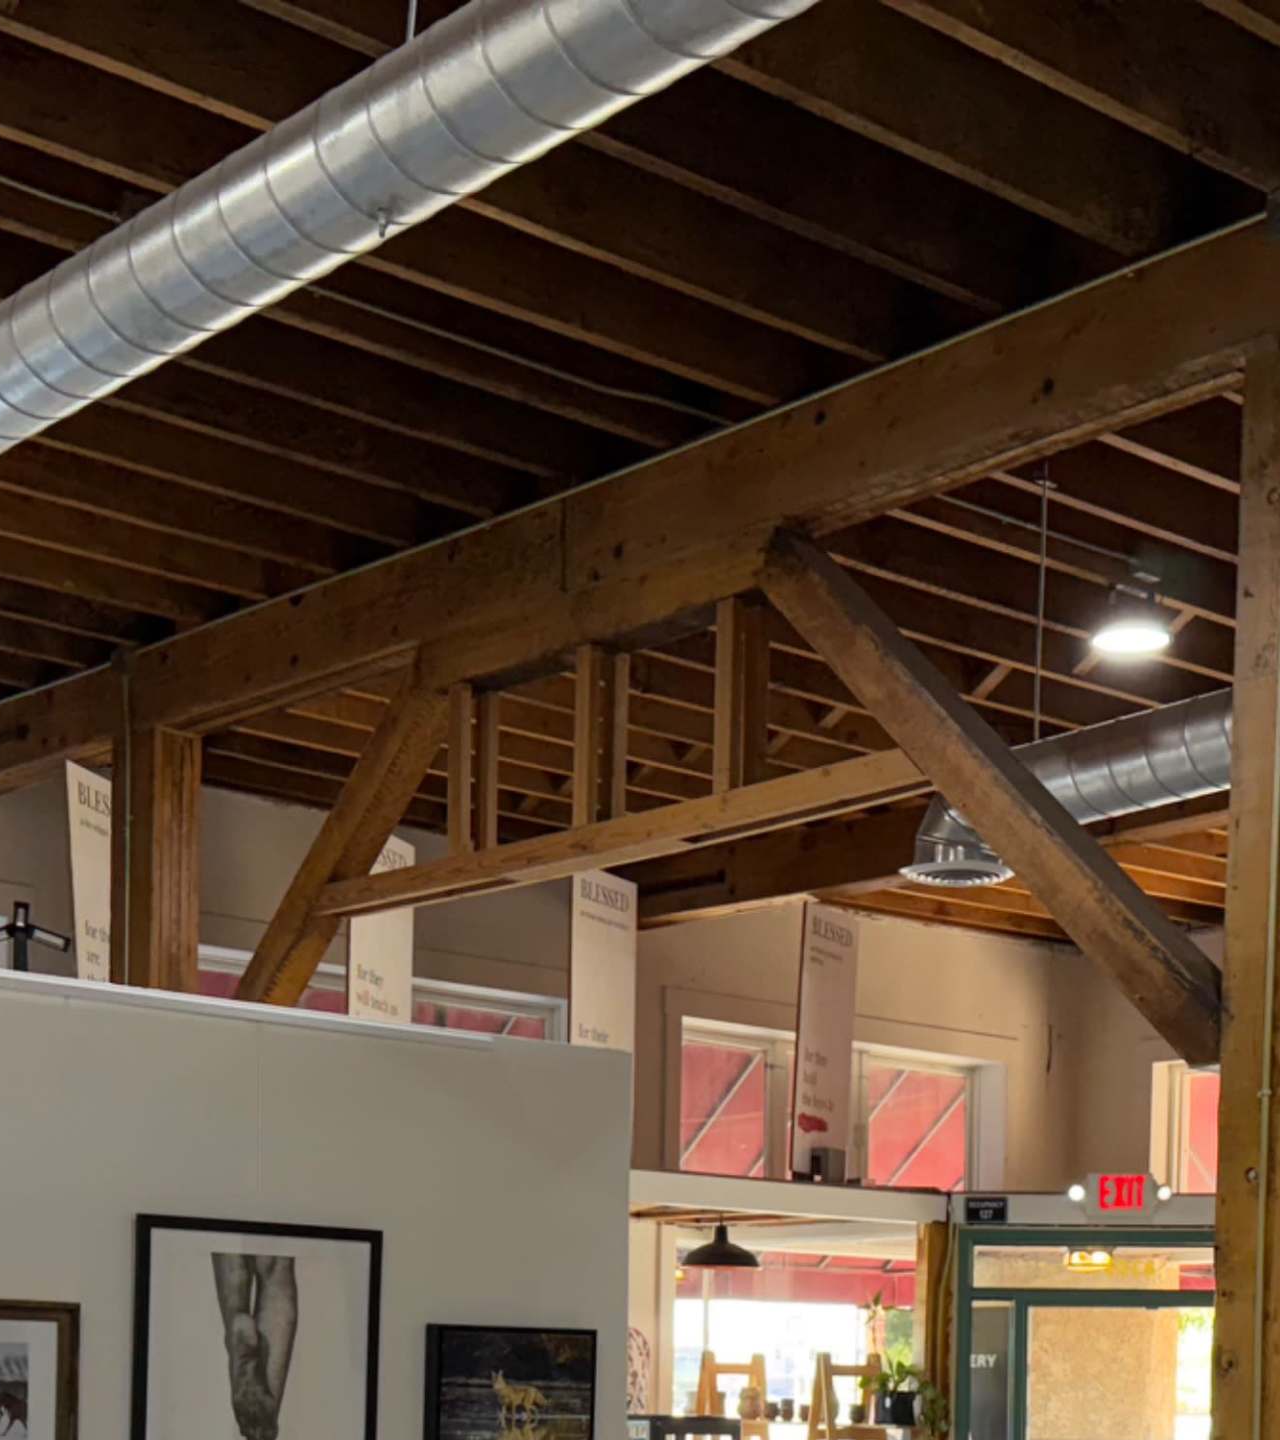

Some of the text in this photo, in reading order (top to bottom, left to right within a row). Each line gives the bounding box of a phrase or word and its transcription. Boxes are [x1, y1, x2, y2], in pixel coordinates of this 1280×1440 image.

[581, 878, 630, 912] BLESSED
[812, 916, 853, 947] BLESSED
[1099, 1174, 1145, 1211] EXIT
